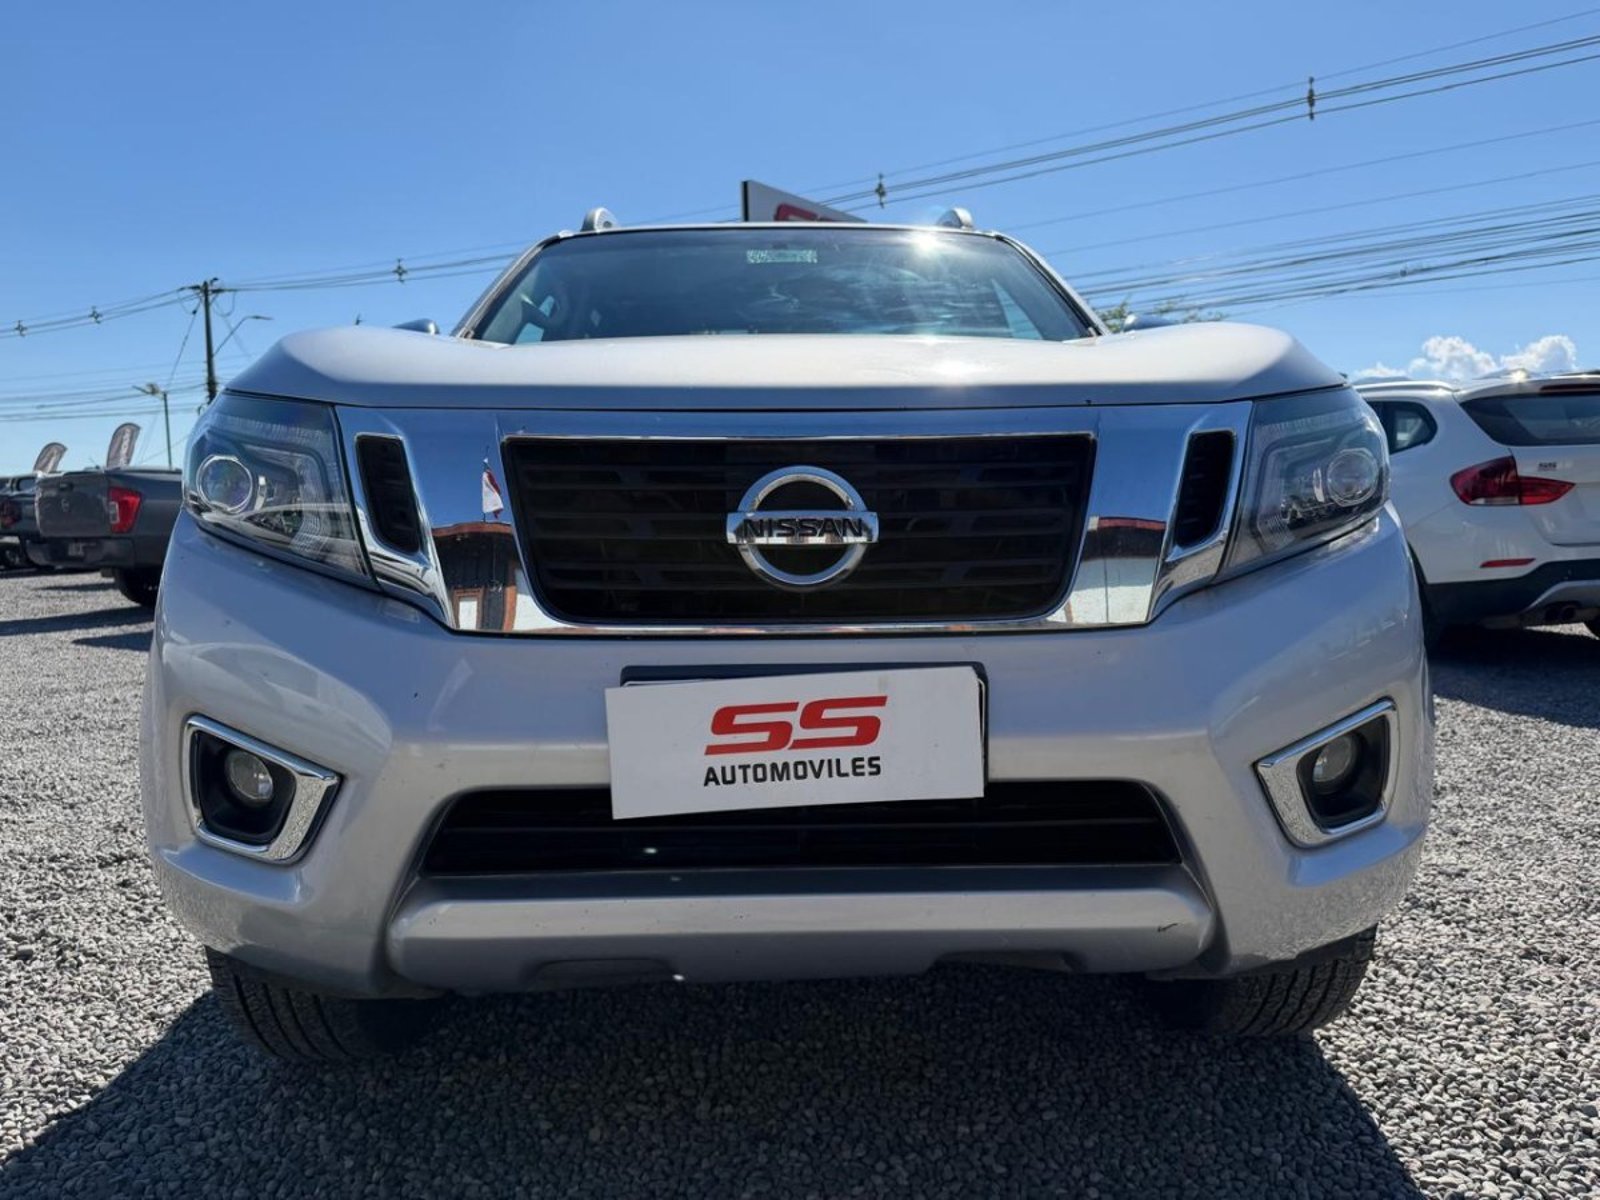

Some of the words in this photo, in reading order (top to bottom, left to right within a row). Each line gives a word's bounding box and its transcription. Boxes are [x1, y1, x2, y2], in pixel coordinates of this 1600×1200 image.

[743, 517, 863, 537] NISSAN
[704, 695, 888, 755] SS
[704, 756, 881, 787] AUTOMOVILES
